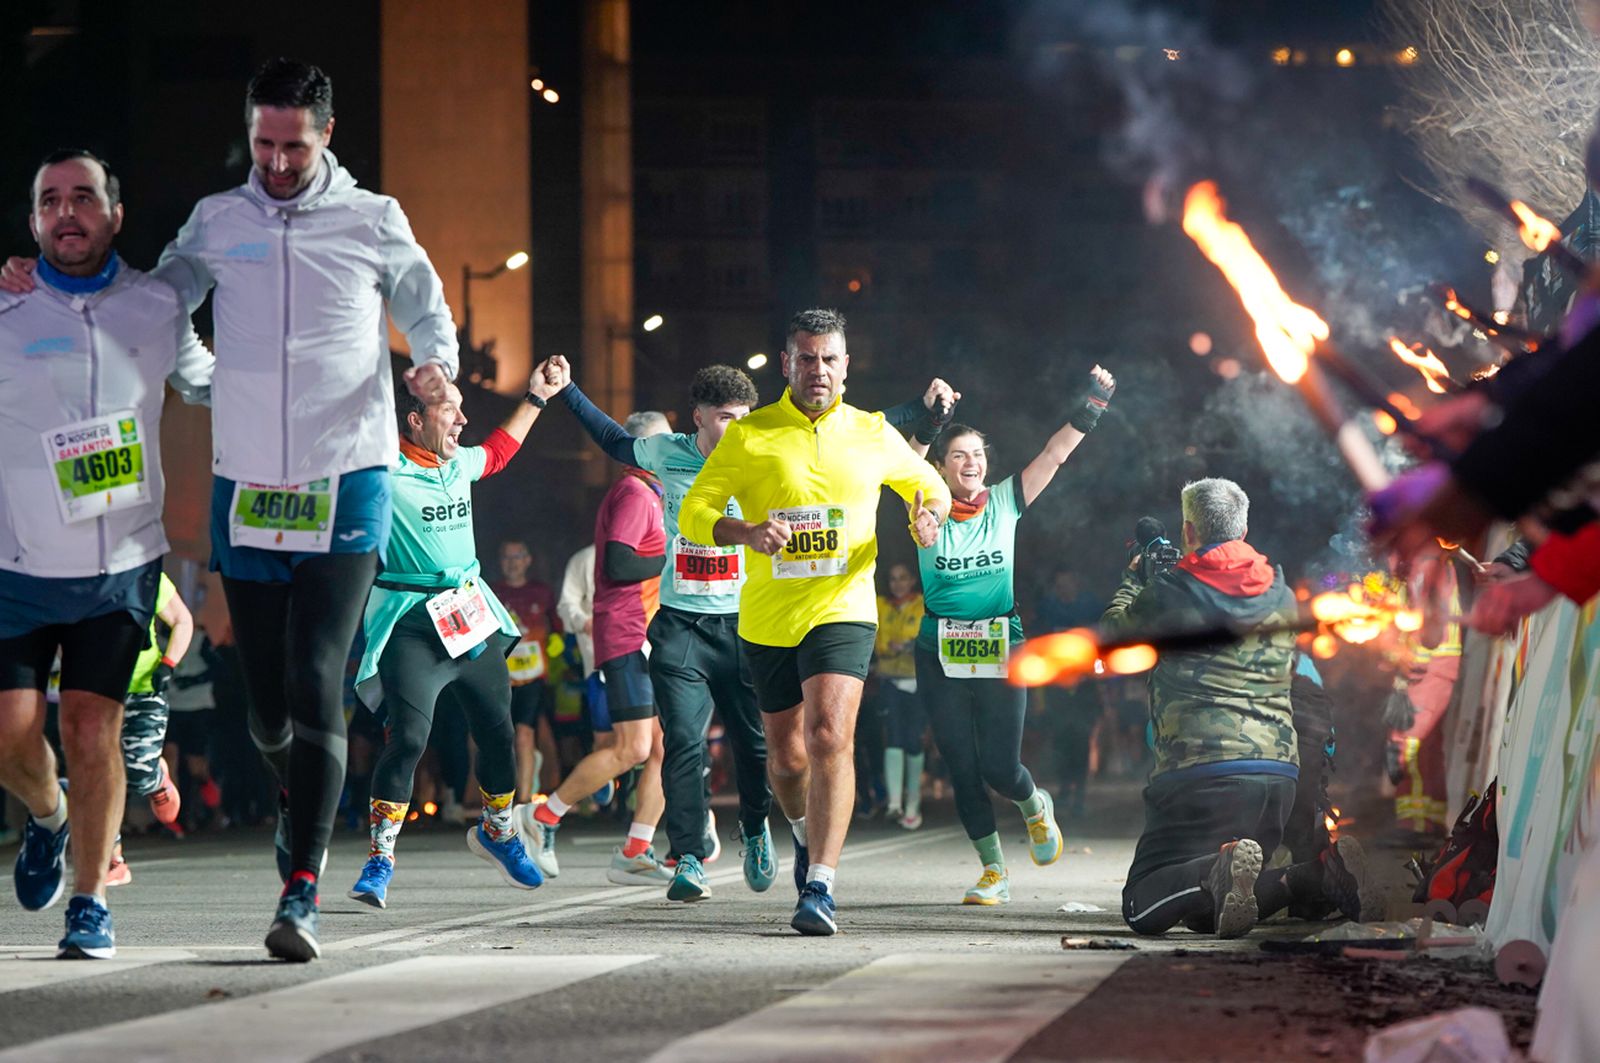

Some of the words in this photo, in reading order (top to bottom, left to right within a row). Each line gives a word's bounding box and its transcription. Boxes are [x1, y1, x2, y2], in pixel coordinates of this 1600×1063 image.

[68, 430, 98, 444] NOCHE
[100, 427, 111, 438] DE
[58, 447, 80, 460] SAN
[73, 447, 133, 485] 4603
[250, 491, 317, 522] 4604
[421, 496, 471, 522] será
[787, 513, 811, 522] NOCHE
[812, 512, 821, 520] DE
[786, 529, 839, 554] 9058
[687, 555, 729, 575] 9769
[935, 549, 1004, 571] serás
[946, 631, 960, 639] SAN
[947, 639, 1000, 658] 12634
